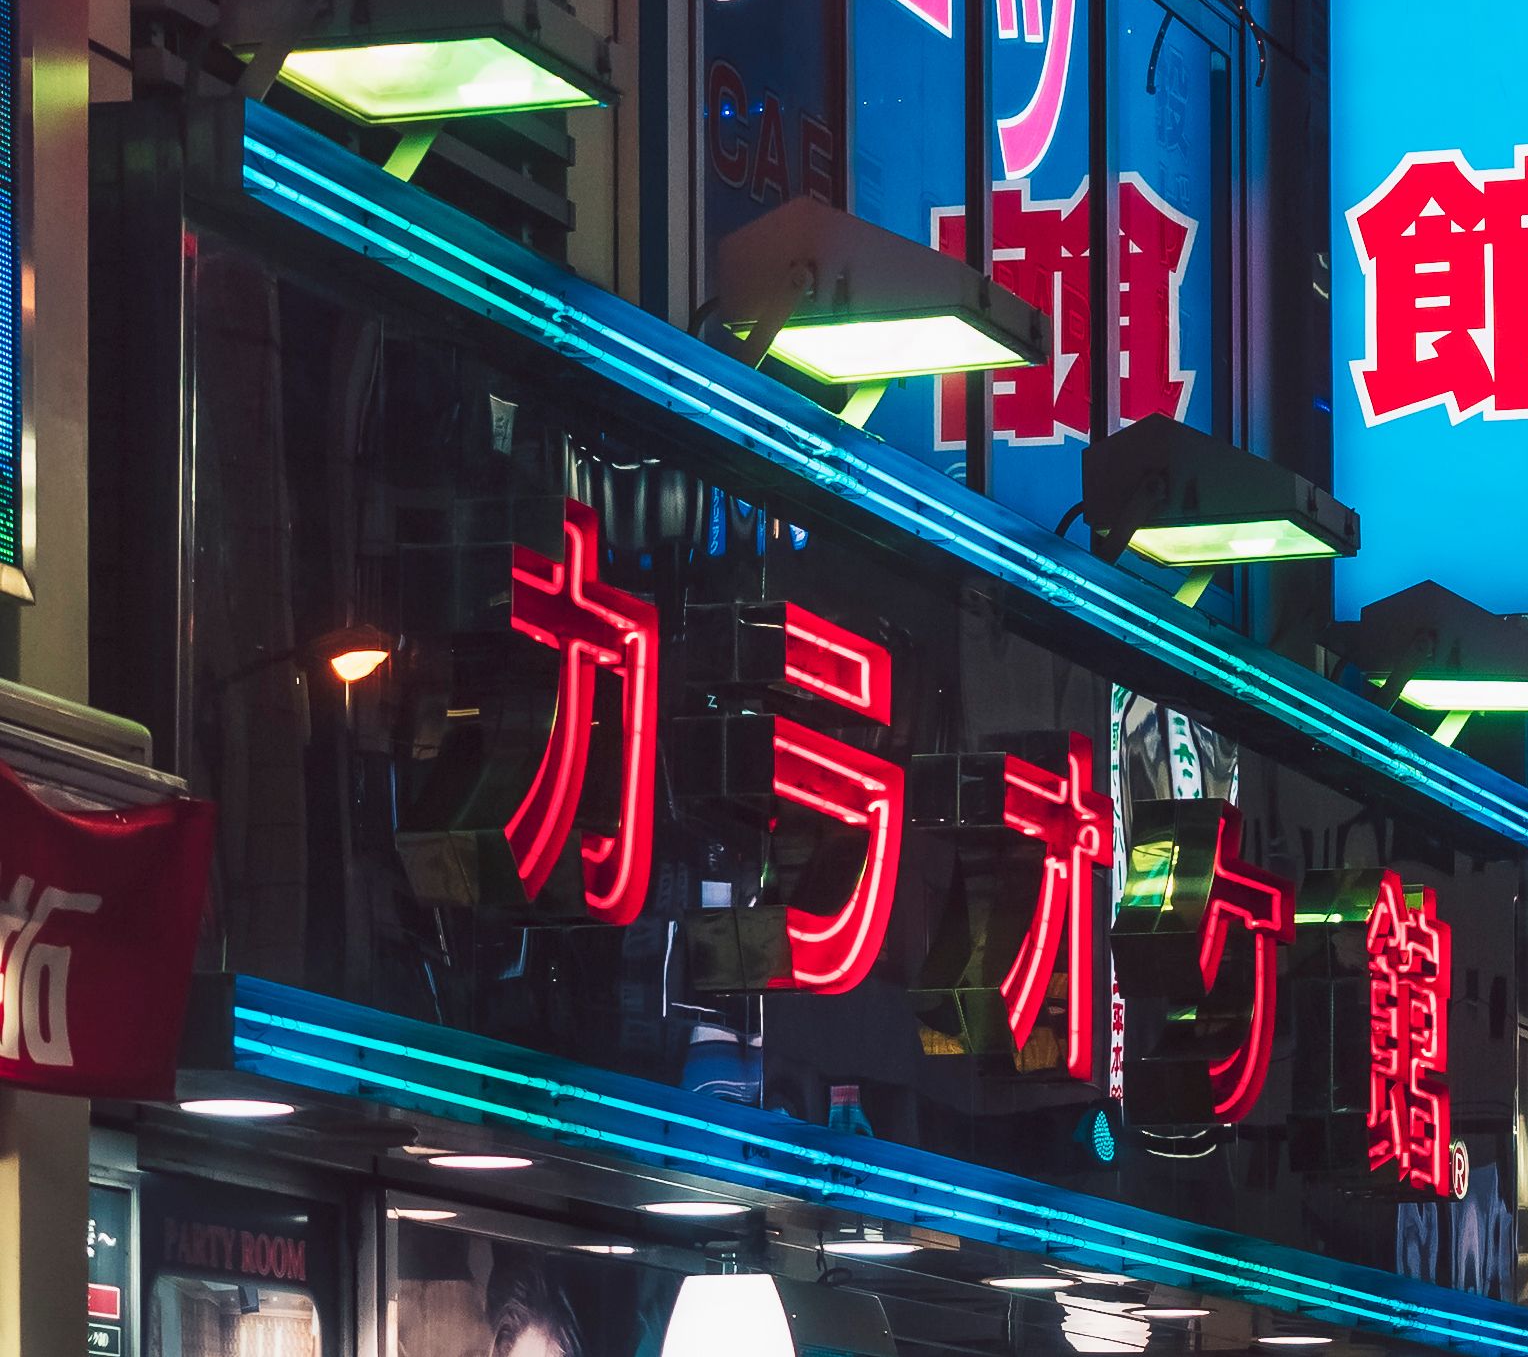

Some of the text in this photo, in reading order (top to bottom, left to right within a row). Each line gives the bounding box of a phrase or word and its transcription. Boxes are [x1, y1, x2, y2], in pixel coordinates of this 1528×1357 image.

[504, 497, 1451, 1196] カラオケ館
[240, 1231, 308, 1283] ROOM
